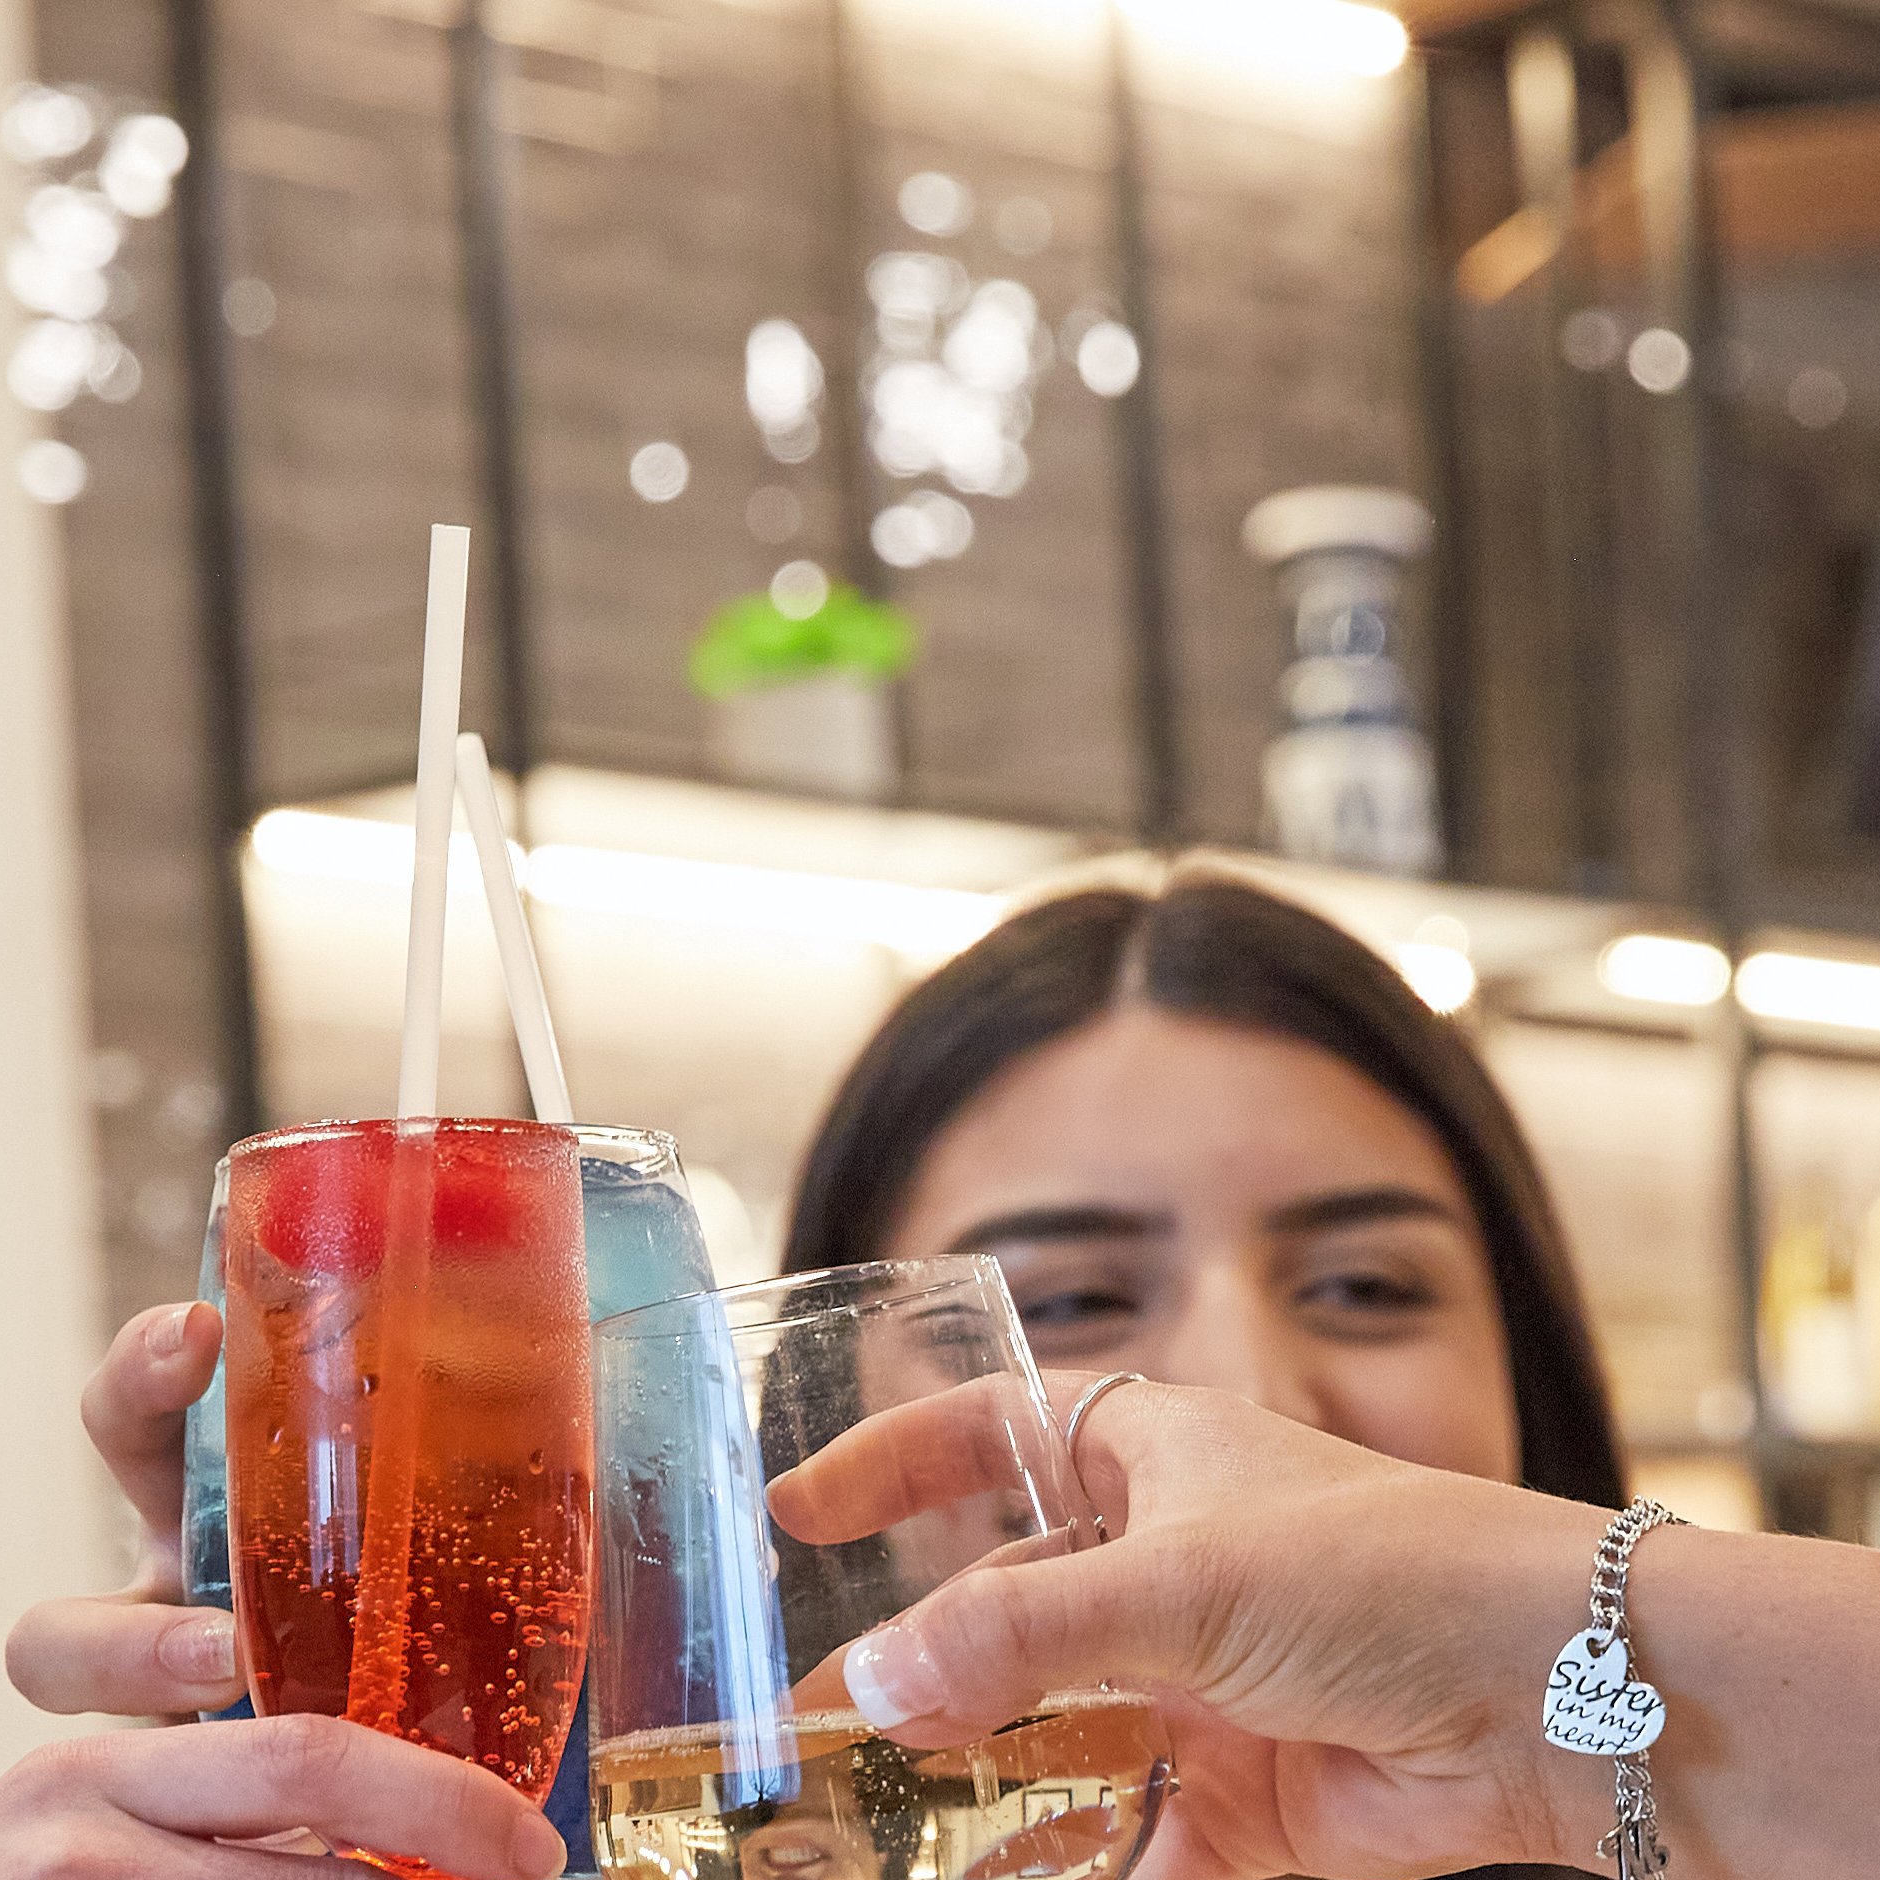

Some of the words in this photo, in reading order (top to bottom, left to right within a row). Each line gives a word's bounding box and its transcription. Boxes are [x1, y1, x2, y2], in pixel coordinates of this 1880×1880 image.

[1549, 1660, 1662, 1717] Sister
[1545, 1715, 1631, 1754] heart
[1556, 1691, 1594, 1718] in
[1599, 1711, 1646, 1742] my
